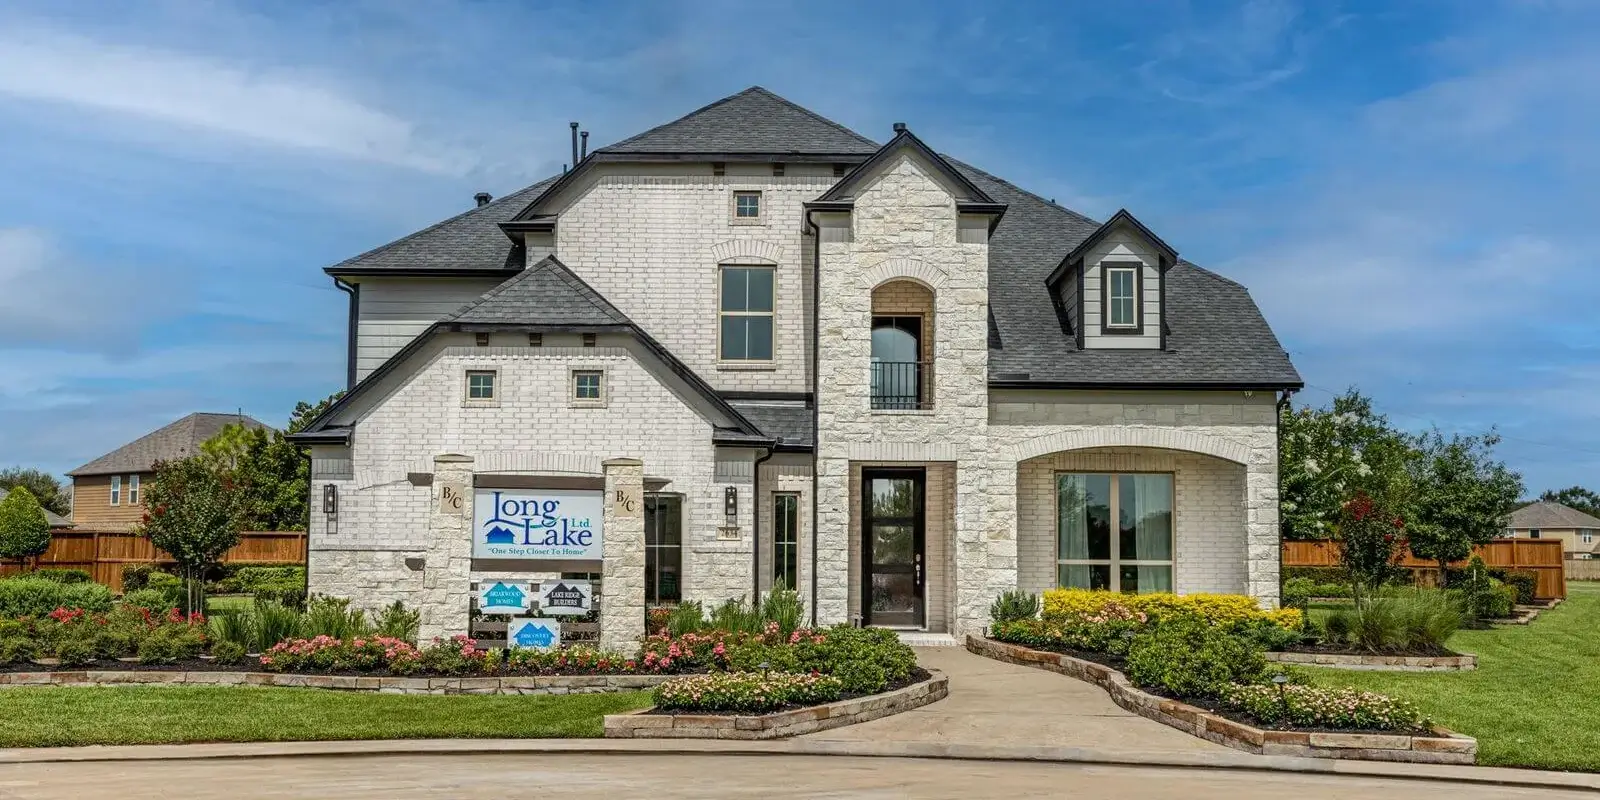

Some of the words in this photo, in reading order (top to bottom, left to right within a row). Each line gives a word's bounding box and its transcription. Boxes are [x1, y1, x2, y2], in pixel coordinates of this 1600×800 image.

[491, 491, 560, 527] Long
[571, 518, 593, 527] Ltd.
[521, 518, 592, 546] Lake
[508, 547, 525, 556] Step
[526, 547, 549, 555] Closer
